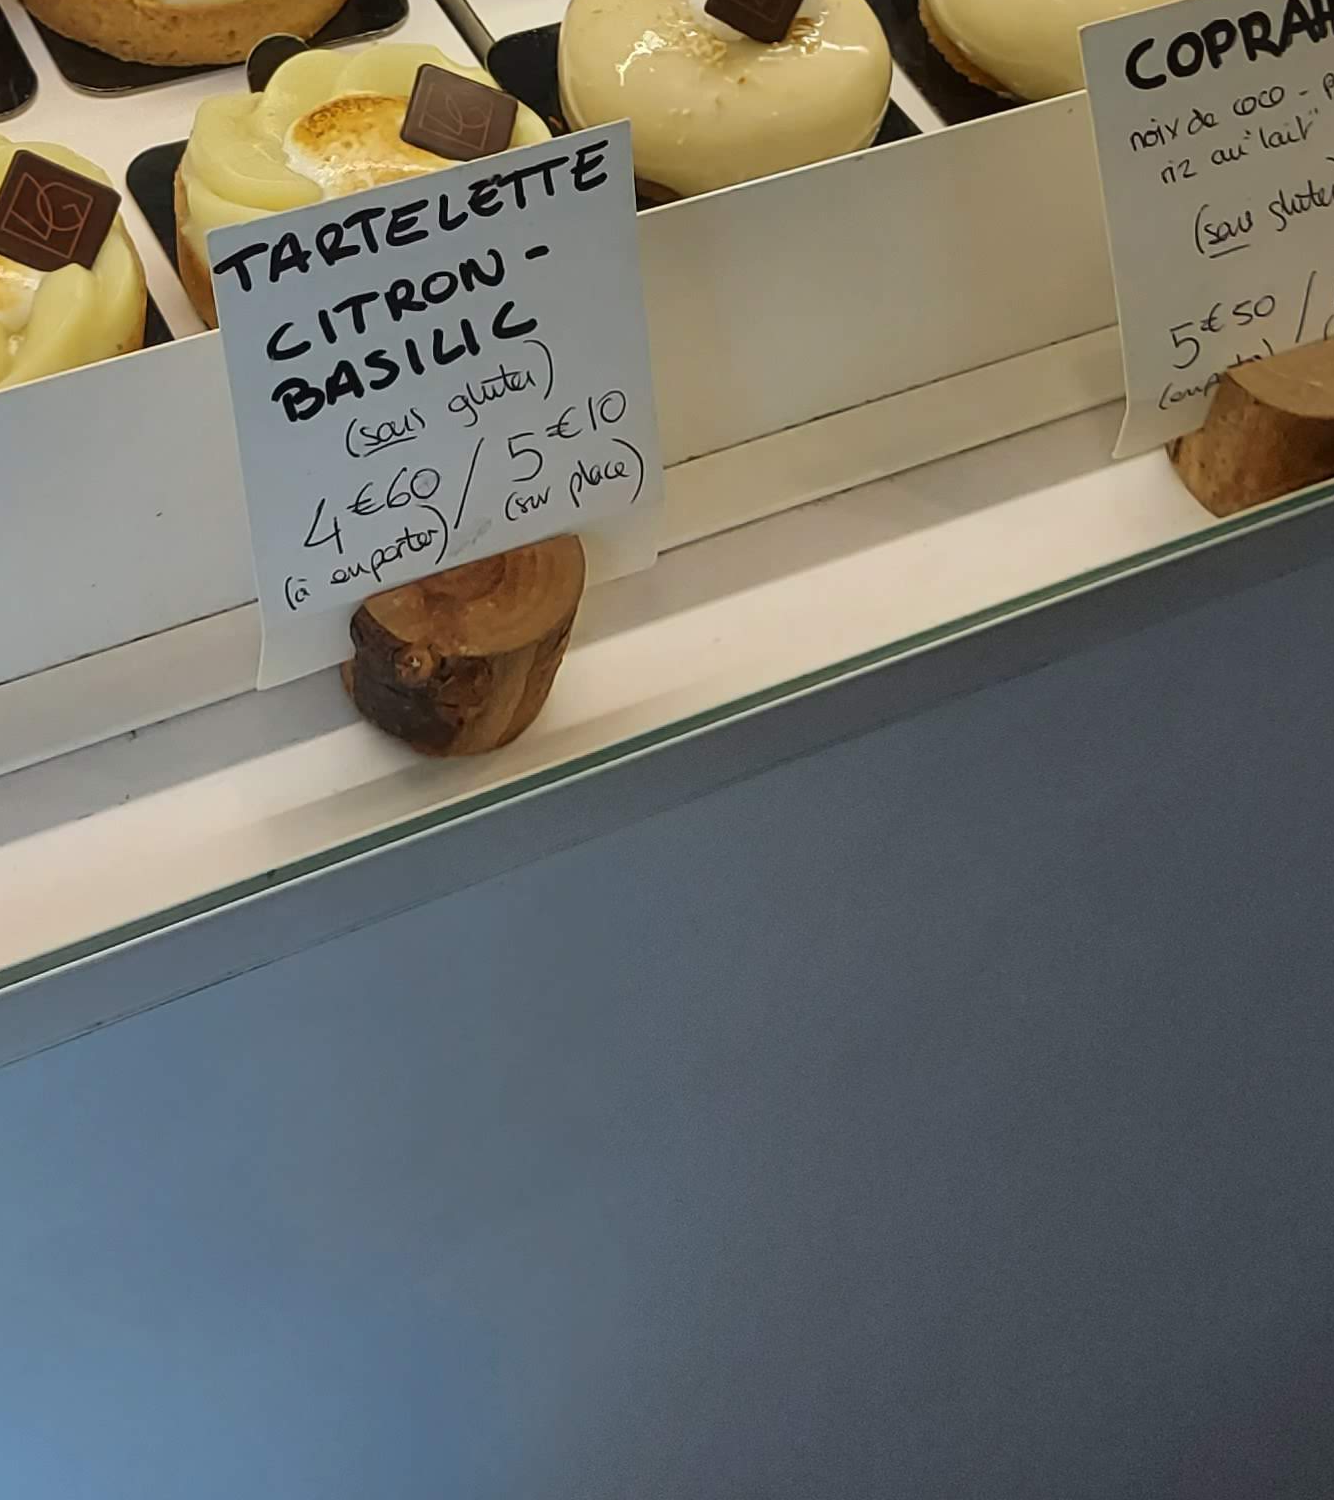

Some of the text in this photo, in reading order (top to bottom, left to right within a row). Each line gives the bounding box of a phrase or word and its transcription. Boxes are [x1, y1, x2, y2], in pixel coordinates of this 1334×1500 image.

[1129, 118, 1180, 151] noix
[1187, 107, 1220, 136] de
[1232, 85, 1286, 117] coco
[1159, 158, 1199, 185] riz
[1210, 145, 1248, 166] au
[212, 139, 610, 293] TARTELETTE
[265, 246, 506, 364] CITRON
[270, 300, 539, 424] BASILIC
[302, 466, 441, 555] 4€60
[506, 388, 628, 483] 5€10
